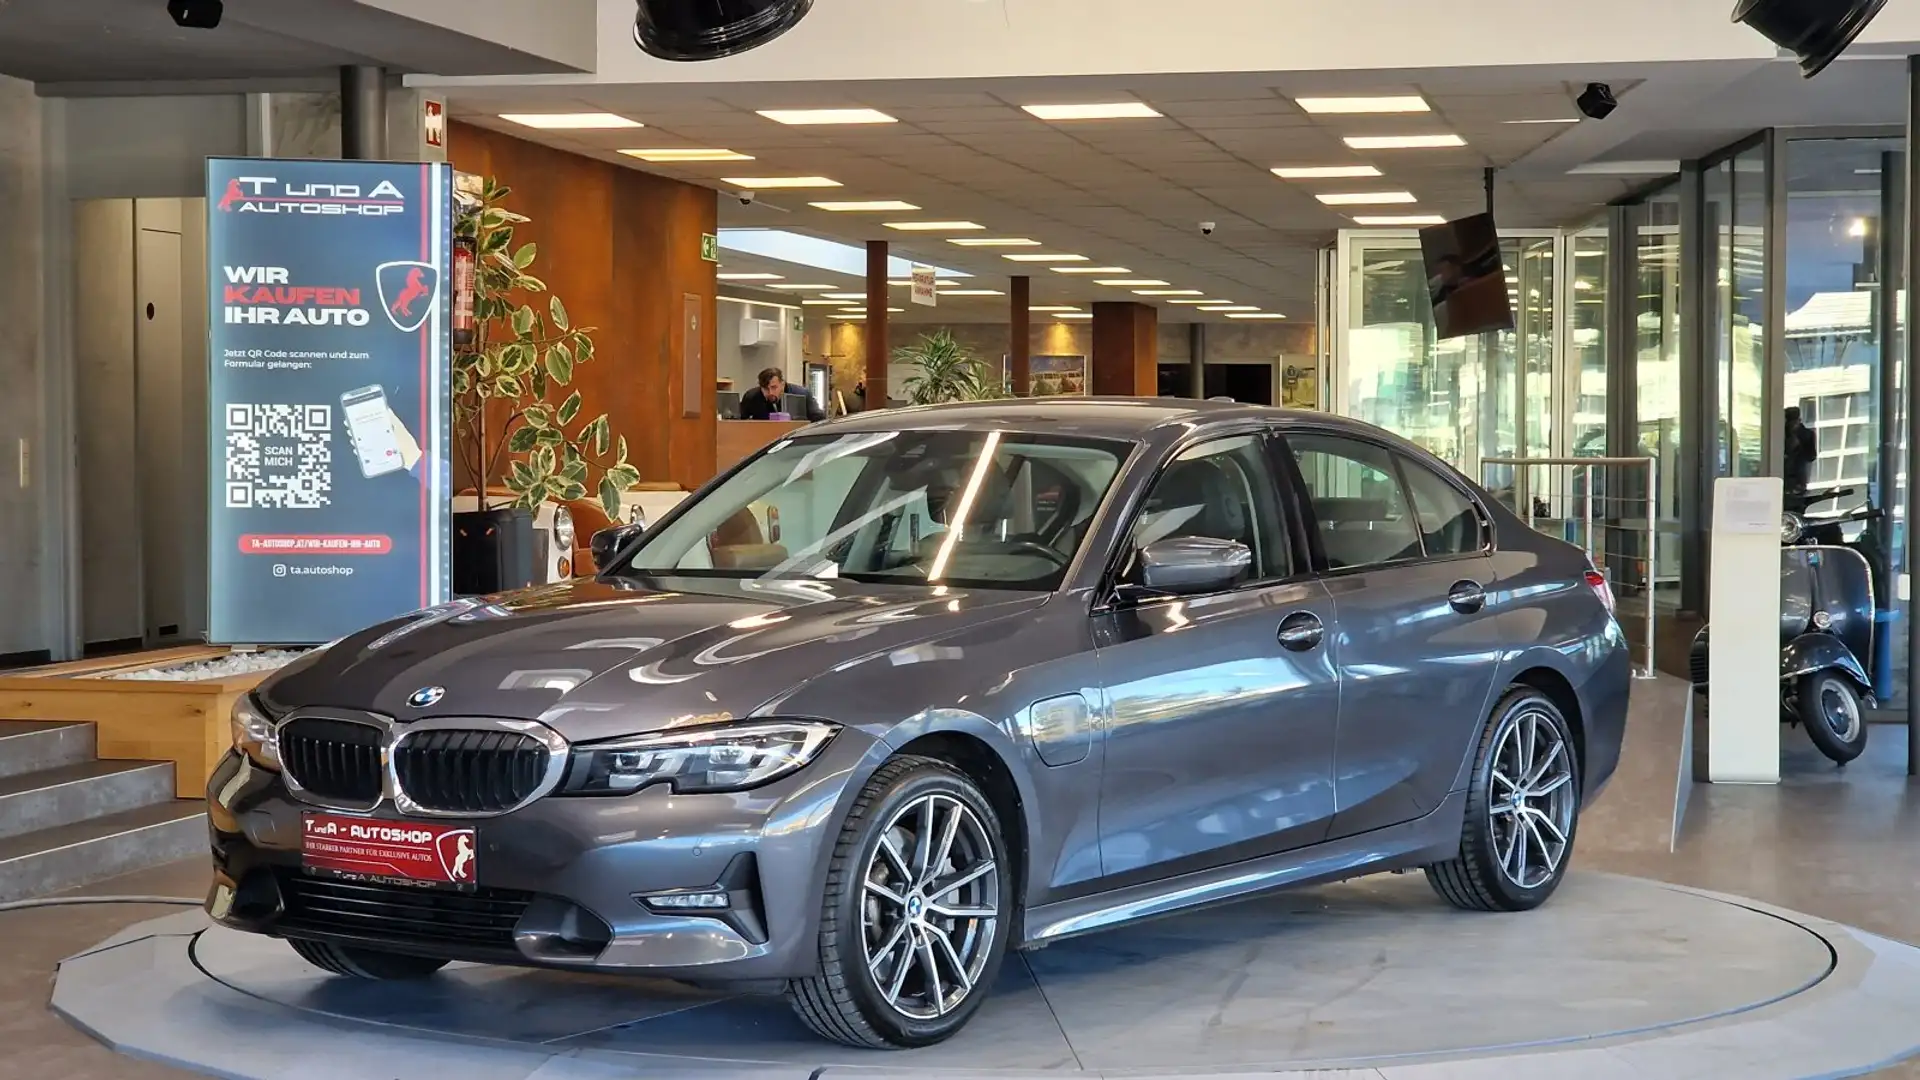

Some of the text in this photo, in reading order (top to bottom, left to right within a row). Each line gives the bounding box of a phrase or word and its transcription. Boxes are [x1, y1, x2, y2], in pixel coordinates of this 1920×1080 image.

[239, 176, 277, 195] T
[367, 180, 405, 199] A
[239, 201, 404, 215] AUTOSHOP
[223, 265, 290, 284] WIR
[224, 285, 361, 305] KAUFEN
[224, 306, 370, 327] IHR AUTO
[224, 349, 246, 358] Jetzt
[247, 350, 262, 359] QR
[264, 350, 287, 358] Code
[289, 350, 328, 359] scannen
[329, 351, 347, 359] und
[224, 360, 313, 370] Formular gelangen:
[264, 446, 293, 455] SCAN
[264, 457, 293, 466] MICH
[290, 565, 354, 576] ta.autoshop
[350, 825, 432, 844] AUTOSHOP
[412, 852, 432, 862] AUTOS
